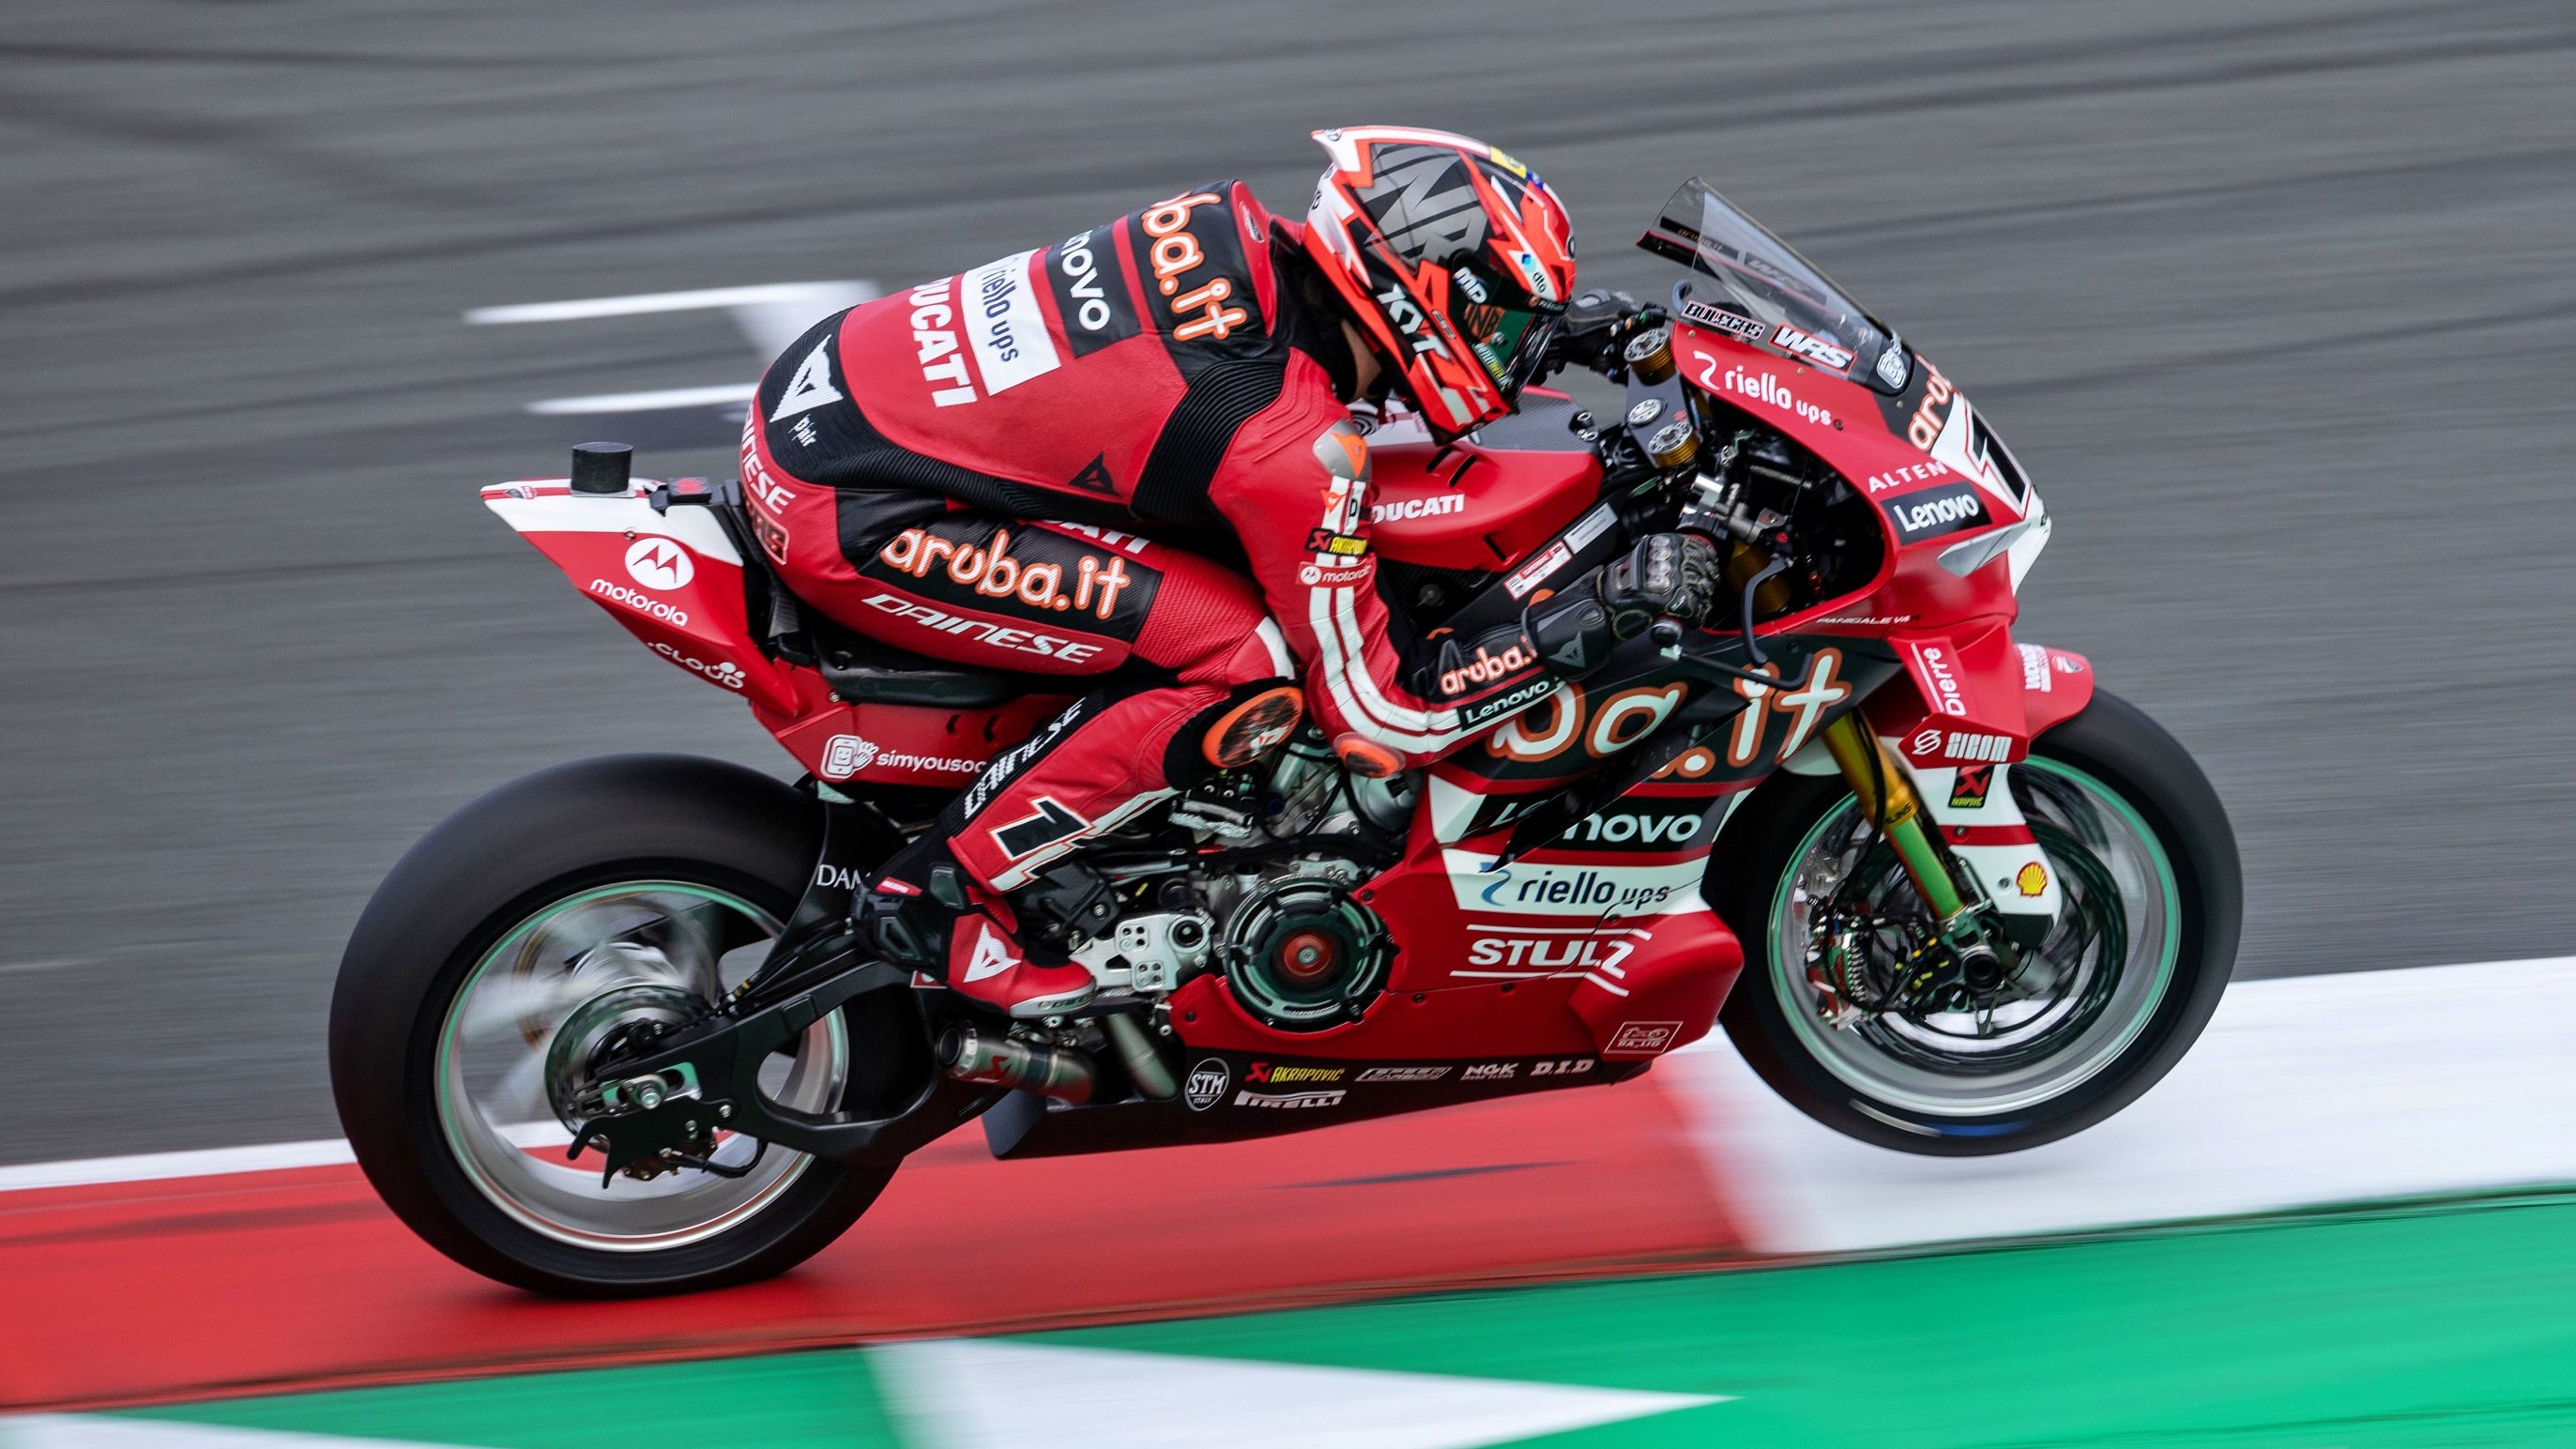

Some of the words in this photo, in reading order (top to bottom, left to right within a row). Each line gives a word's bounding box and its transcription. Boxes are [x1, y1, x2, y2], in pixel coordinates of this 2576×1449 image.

[1061, 230, 1111, 330] novo
[1141, 191, 1247, 342] ba.it
[988, 321, 1019, 363] ups
[1376, 283, 1451, 361] KYT
[1725, 365, 1792, 410] riello
[1795, 400, 1832, 426] ups
[738, 402, 796, 515] AINESE
[1867, 460, 1949, 493] ALTEN
[1372, 494, 1465, 525] DUCATI
[1893, 494, 1980, 532] Lenovo
[880, 528, 1130, 619] aruba.it
[589, 578, 689, 627] motorola
[861, 593, 1104, 664] DAINESE
[1440, 633, 1539, 696] aruba.i
[1465, 679, 1549, 724] Lenovo
[1485, 648, 1852, 777] ba.it
[989, 796, 1091, 863] 1
[1517, 871, 1617, 905] riello
[1621, 886, 1671, 911] ups
[1467, 937, 1636, 980] STULZ
[1188, 1073, 1227, 1095] STM
[1465, 1062, 1519, 1076] NGK
[1530, 1059, 1594, 1076] D.I.D
[1233, 1090, 1348, 1109] PIRELLI
